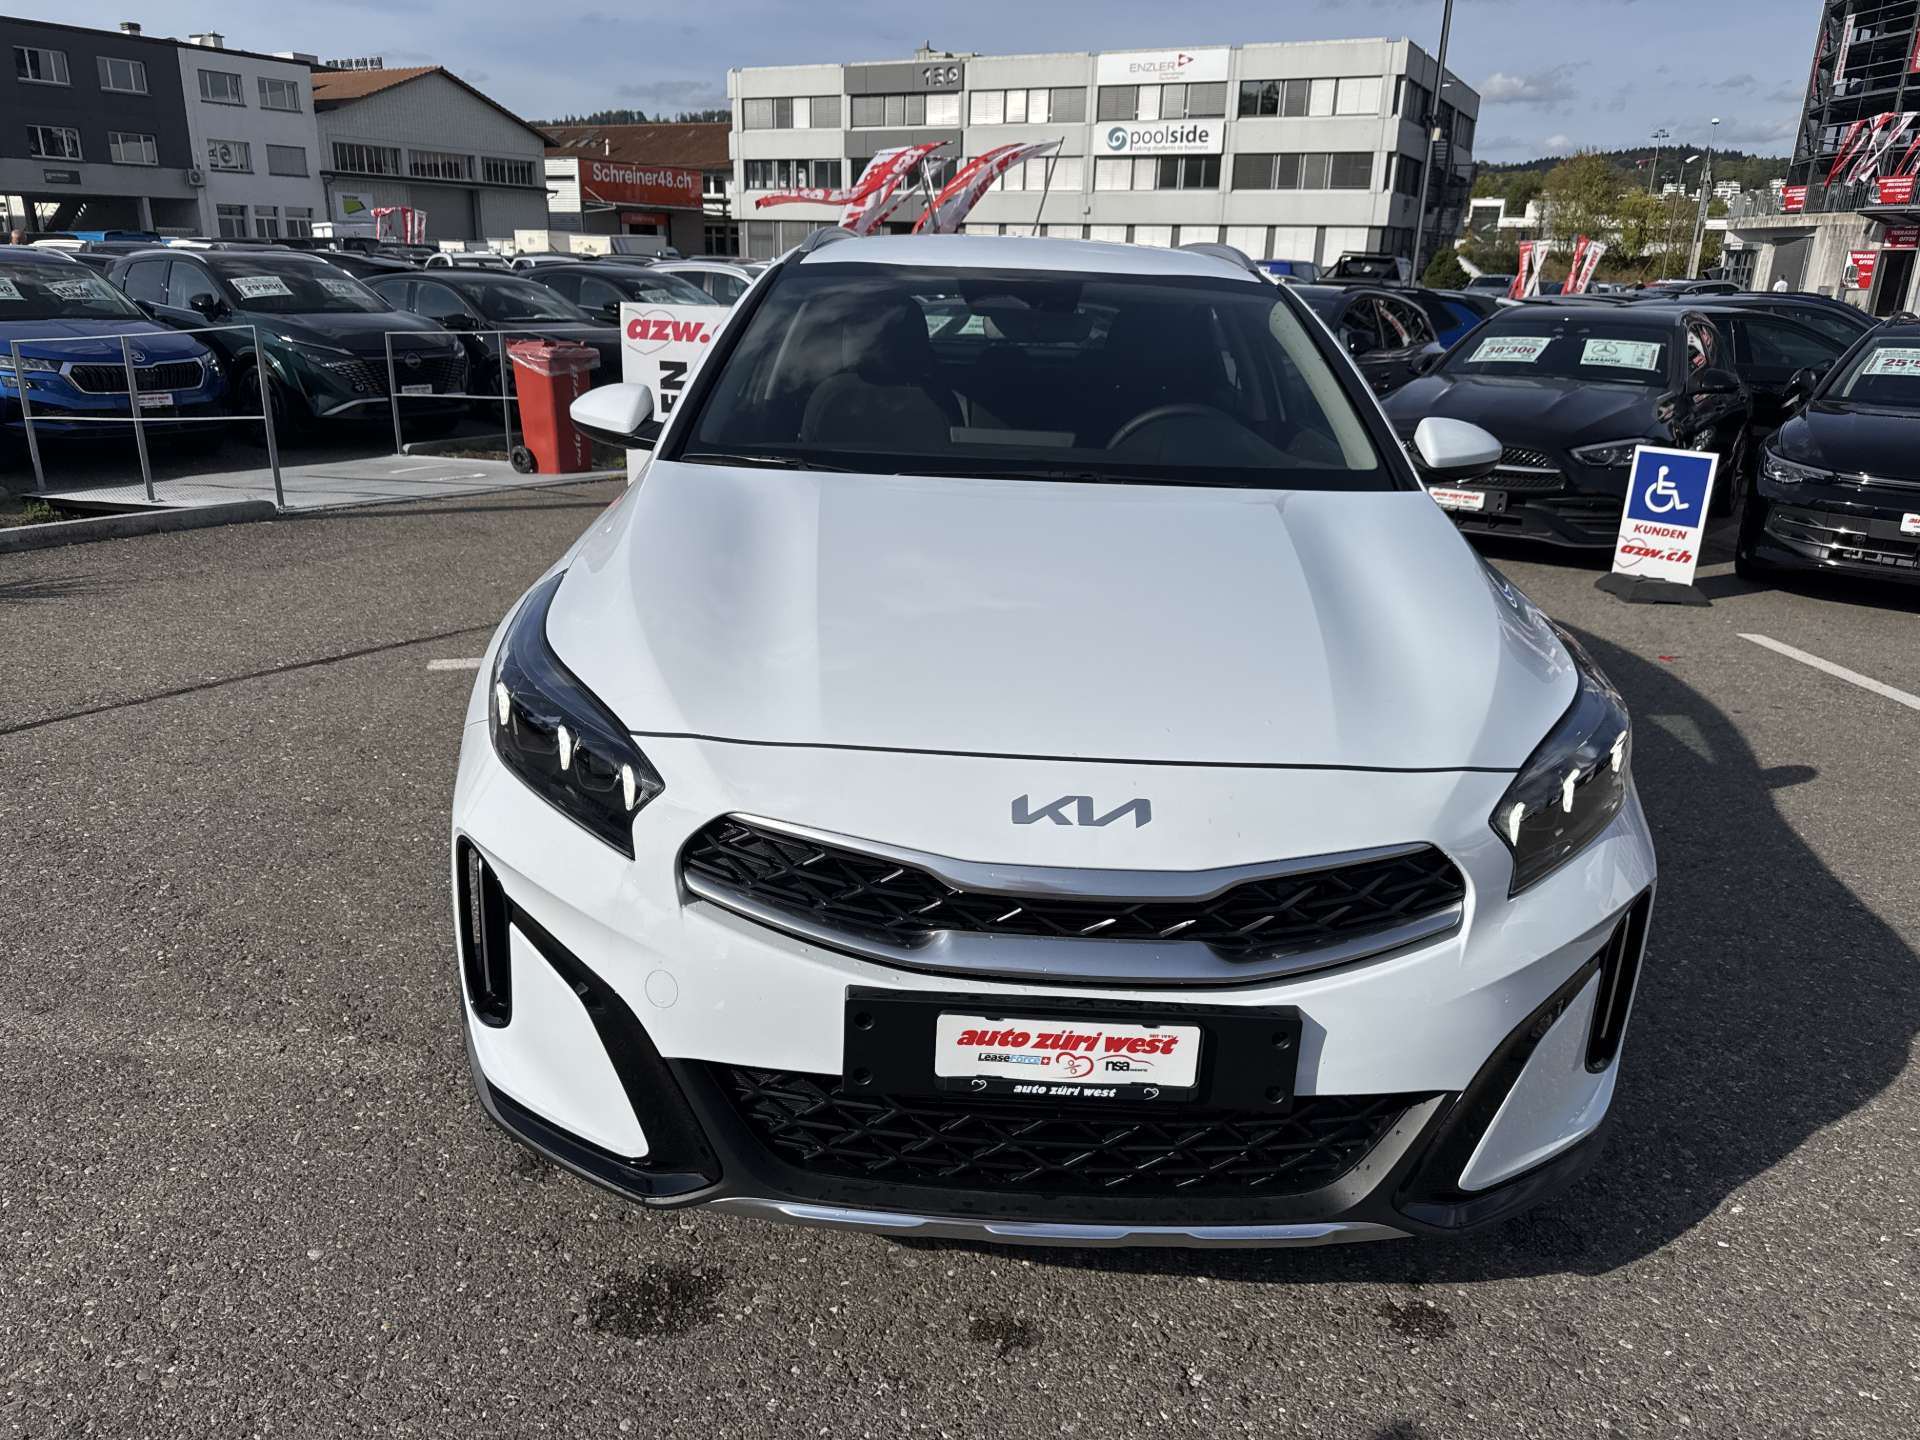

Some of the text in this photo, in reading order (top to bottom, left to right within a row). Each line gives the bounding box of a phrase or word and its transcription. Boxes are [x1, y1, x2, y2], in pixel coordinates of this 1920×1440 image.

[1129, 62, 1175, 73] ENZLER
[1129, 124, 1209, 151] poolside
[592, 163, 692, 189] Schreiner48.ch
[627, 318, 720, 343] azw.
[1487, 345, 1537, 354] 38'300
[1633, 524, 1687, 540] KUNDEN
[1620, 545, 1692, 564] azw.ch
[957, 1028, 1179, 1054] auto züri west
[1105, 1060, 1130, 1072] nsa
[1013, 1084, 1117, 1098] auto züri west
